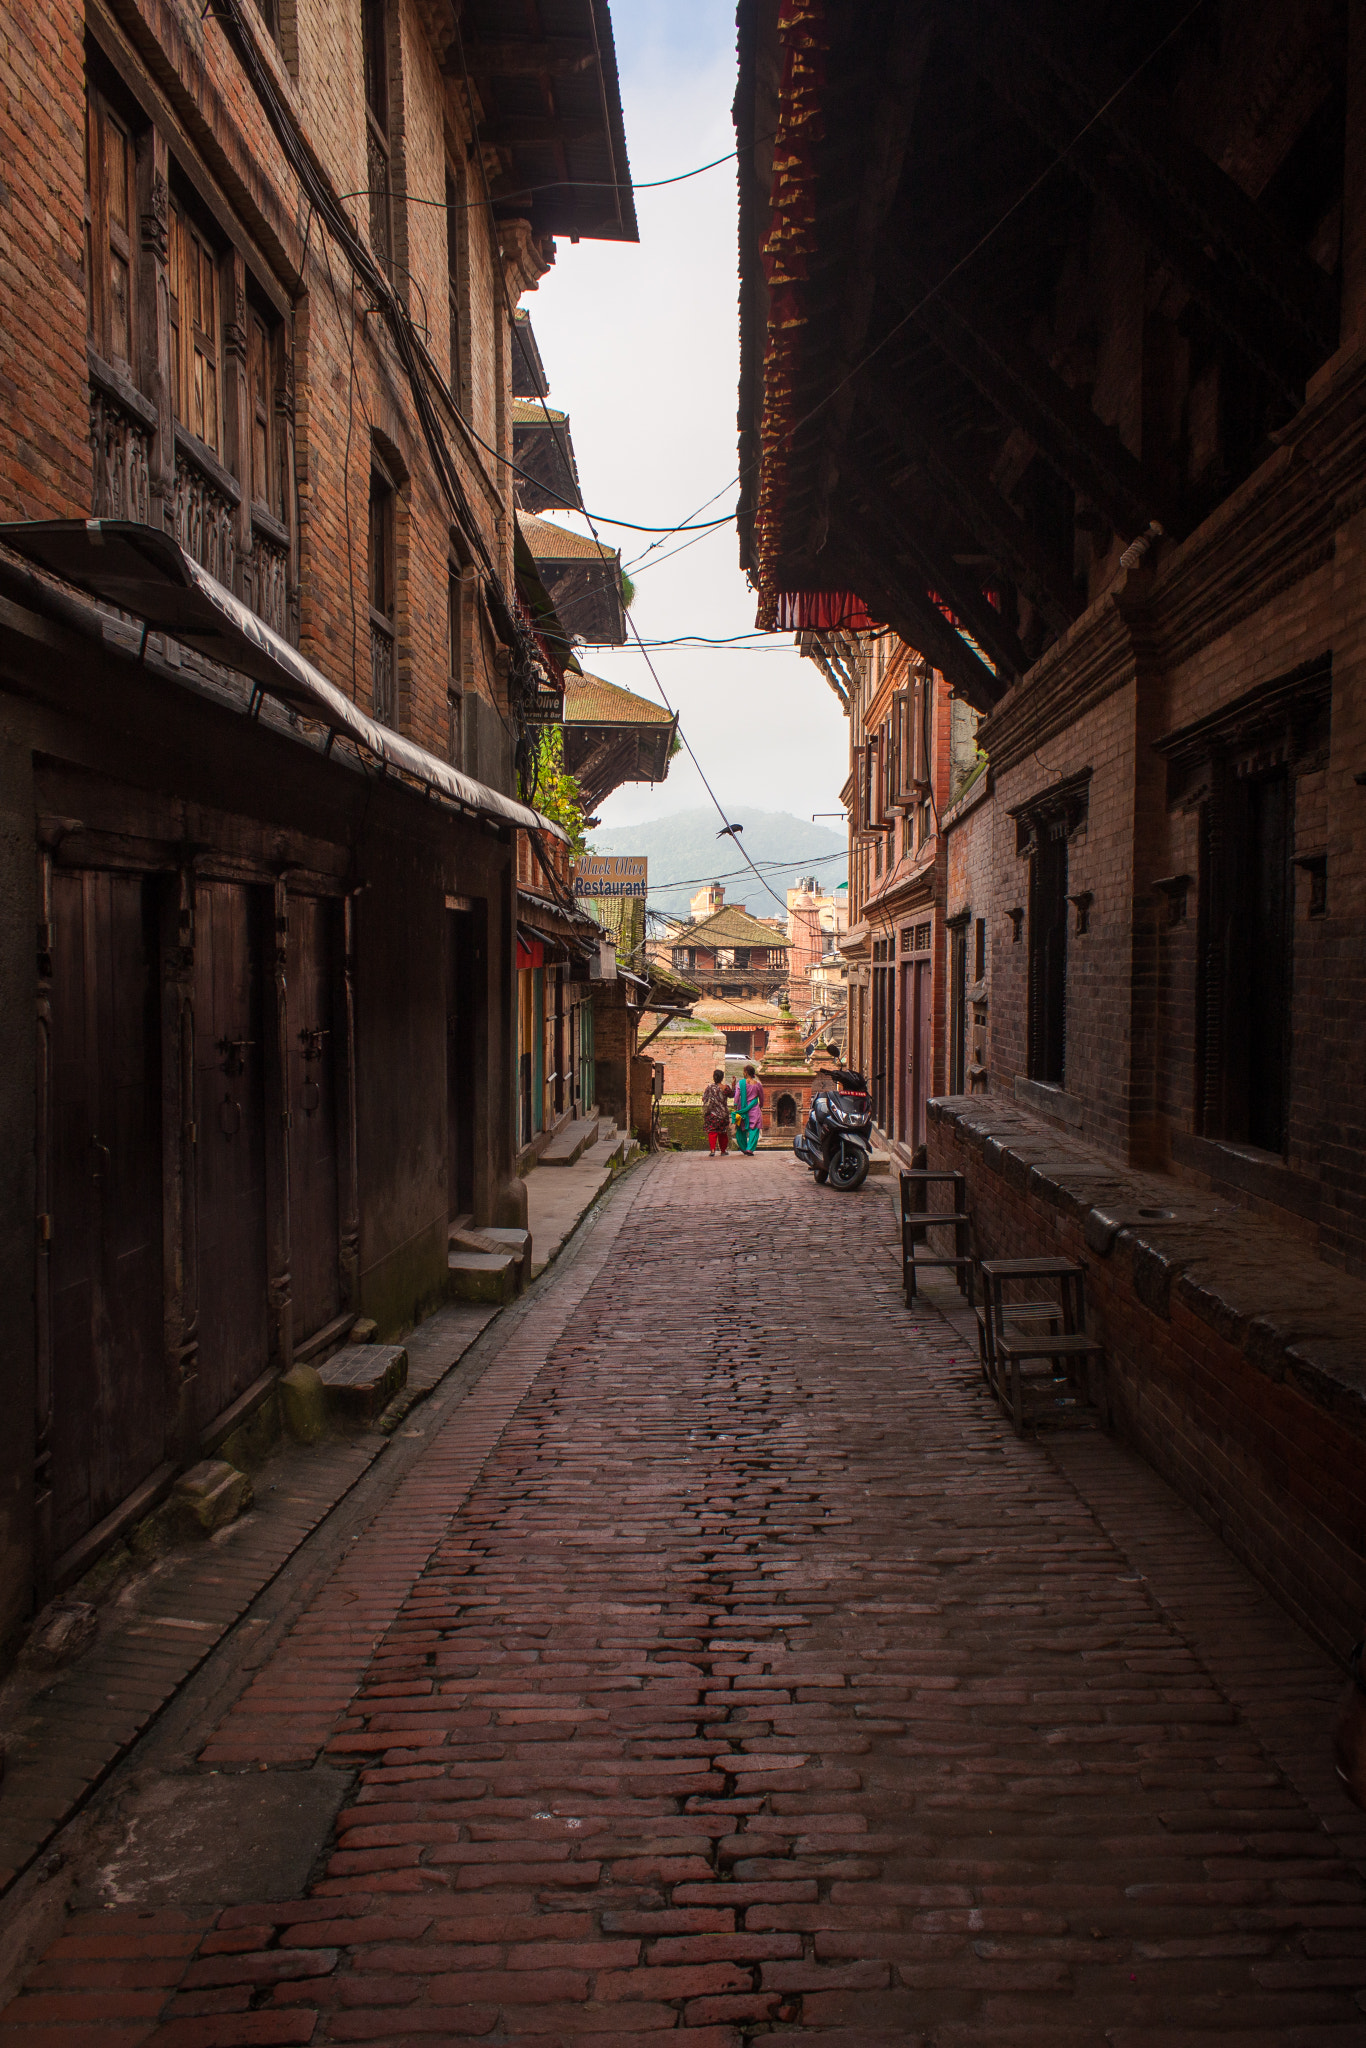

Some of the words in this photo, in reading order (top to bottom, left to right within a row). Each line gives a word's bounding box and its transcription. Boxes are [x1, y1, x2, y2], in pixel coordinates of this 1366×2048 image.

[578, 856, 610, 876] Black
[615, 857, 644, 875] Olive
[575, 877, 646, 896] Restaurant
